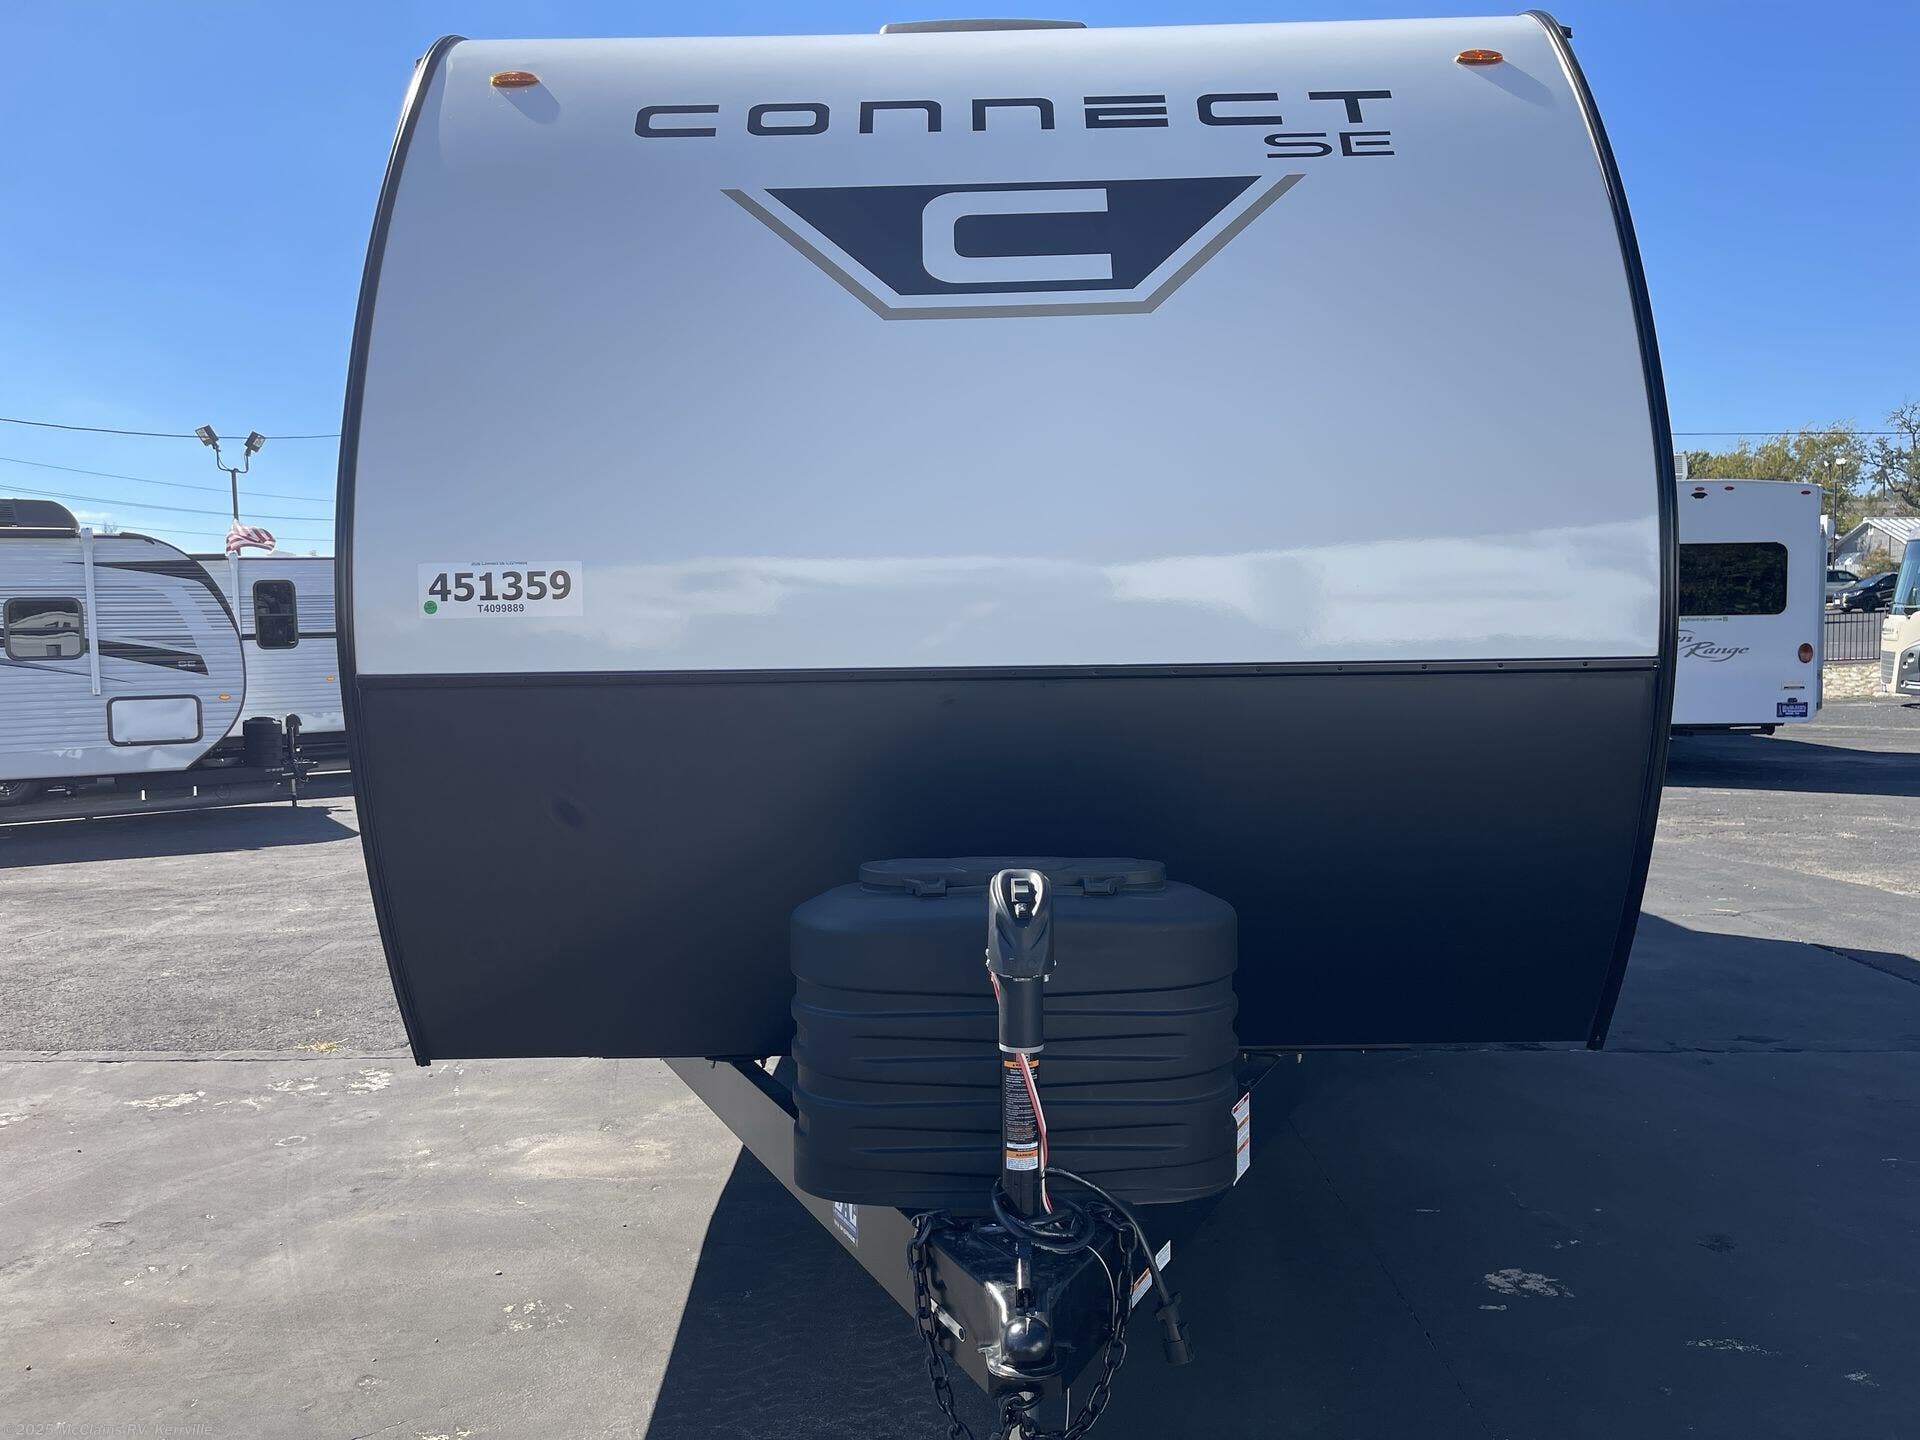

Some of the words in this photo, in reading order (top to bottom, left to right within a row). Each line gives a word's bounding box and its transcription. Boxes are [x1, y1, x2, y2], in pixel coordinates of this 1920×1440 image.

[634, 90, 1392, 138] CONNECT
[1264, 131, 1395, 158] SE
[921, 188, 1113, 284] C
[428, 570, 571, 602] 451359
[477, 603, 525, 613] T4099889
[1680, 641, 1750, 663] Range
